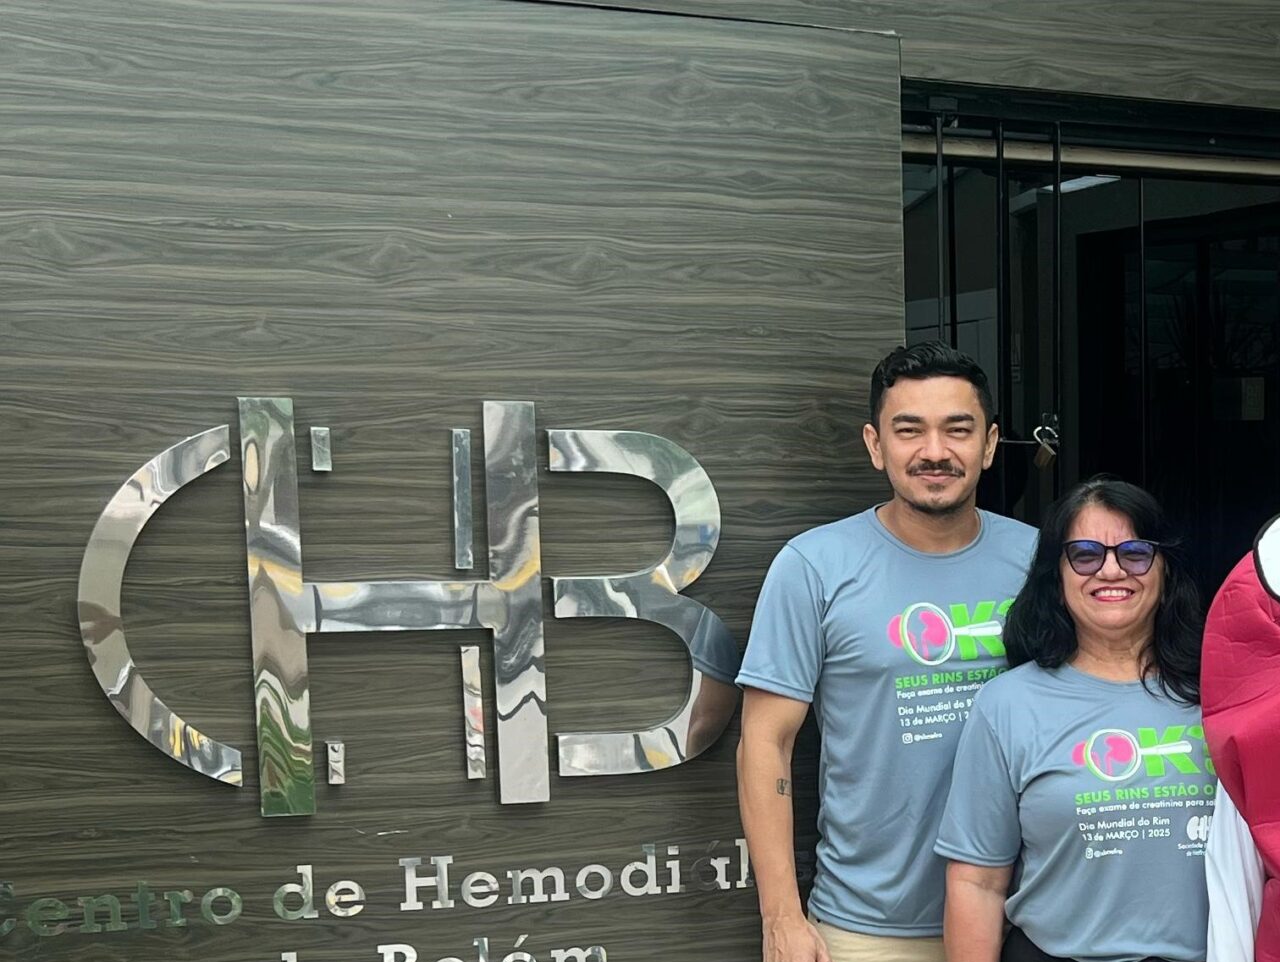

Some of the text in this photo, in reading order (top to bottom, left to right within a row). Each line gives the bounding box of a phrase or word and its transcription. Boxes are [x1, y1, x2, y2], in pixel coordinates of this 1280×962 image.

[77, 396, 742, 817] CHB
[895, 674, 929, 690] SEUS
[932, 671, 963, 685] RINS
[897, 690, 916, 700] Faça
[944, 685, 954, 694] de
[897, 705, 914, 716] Dia
[916, 701, 952, 714] Mundial
[953, 699, 965, 709] do
[900, 718, 911, 727] 13
[912, 716, 923, 726] de
[925, 712, 956, 724] MARÇO
[1075, 789, 1111, 806] SEUS
[1115, 787, 1149, 801] RINS
[1154, 782, 1199, 798] ESTÃO
[1076, 806, 1097, 816] Faça
[1099, 803, 1127, 813] exame
[1129, 802, 1140, 810] de
[1142, 799, 1183, 808] creatinina
[1185, 799, 1204, 808] para
[1078, 816, 1170, 832] Dia Mundial do Rim
[1082, 832, 1093, 841] 13
[1093, 831, 1104, 841] de
[1105, 829, 1139, 841] MARÇO
[1148, 828, 1171, 838] 2025
[273, 864, 367, 921] de
[399, 837, 756, 911] Hemodiál
